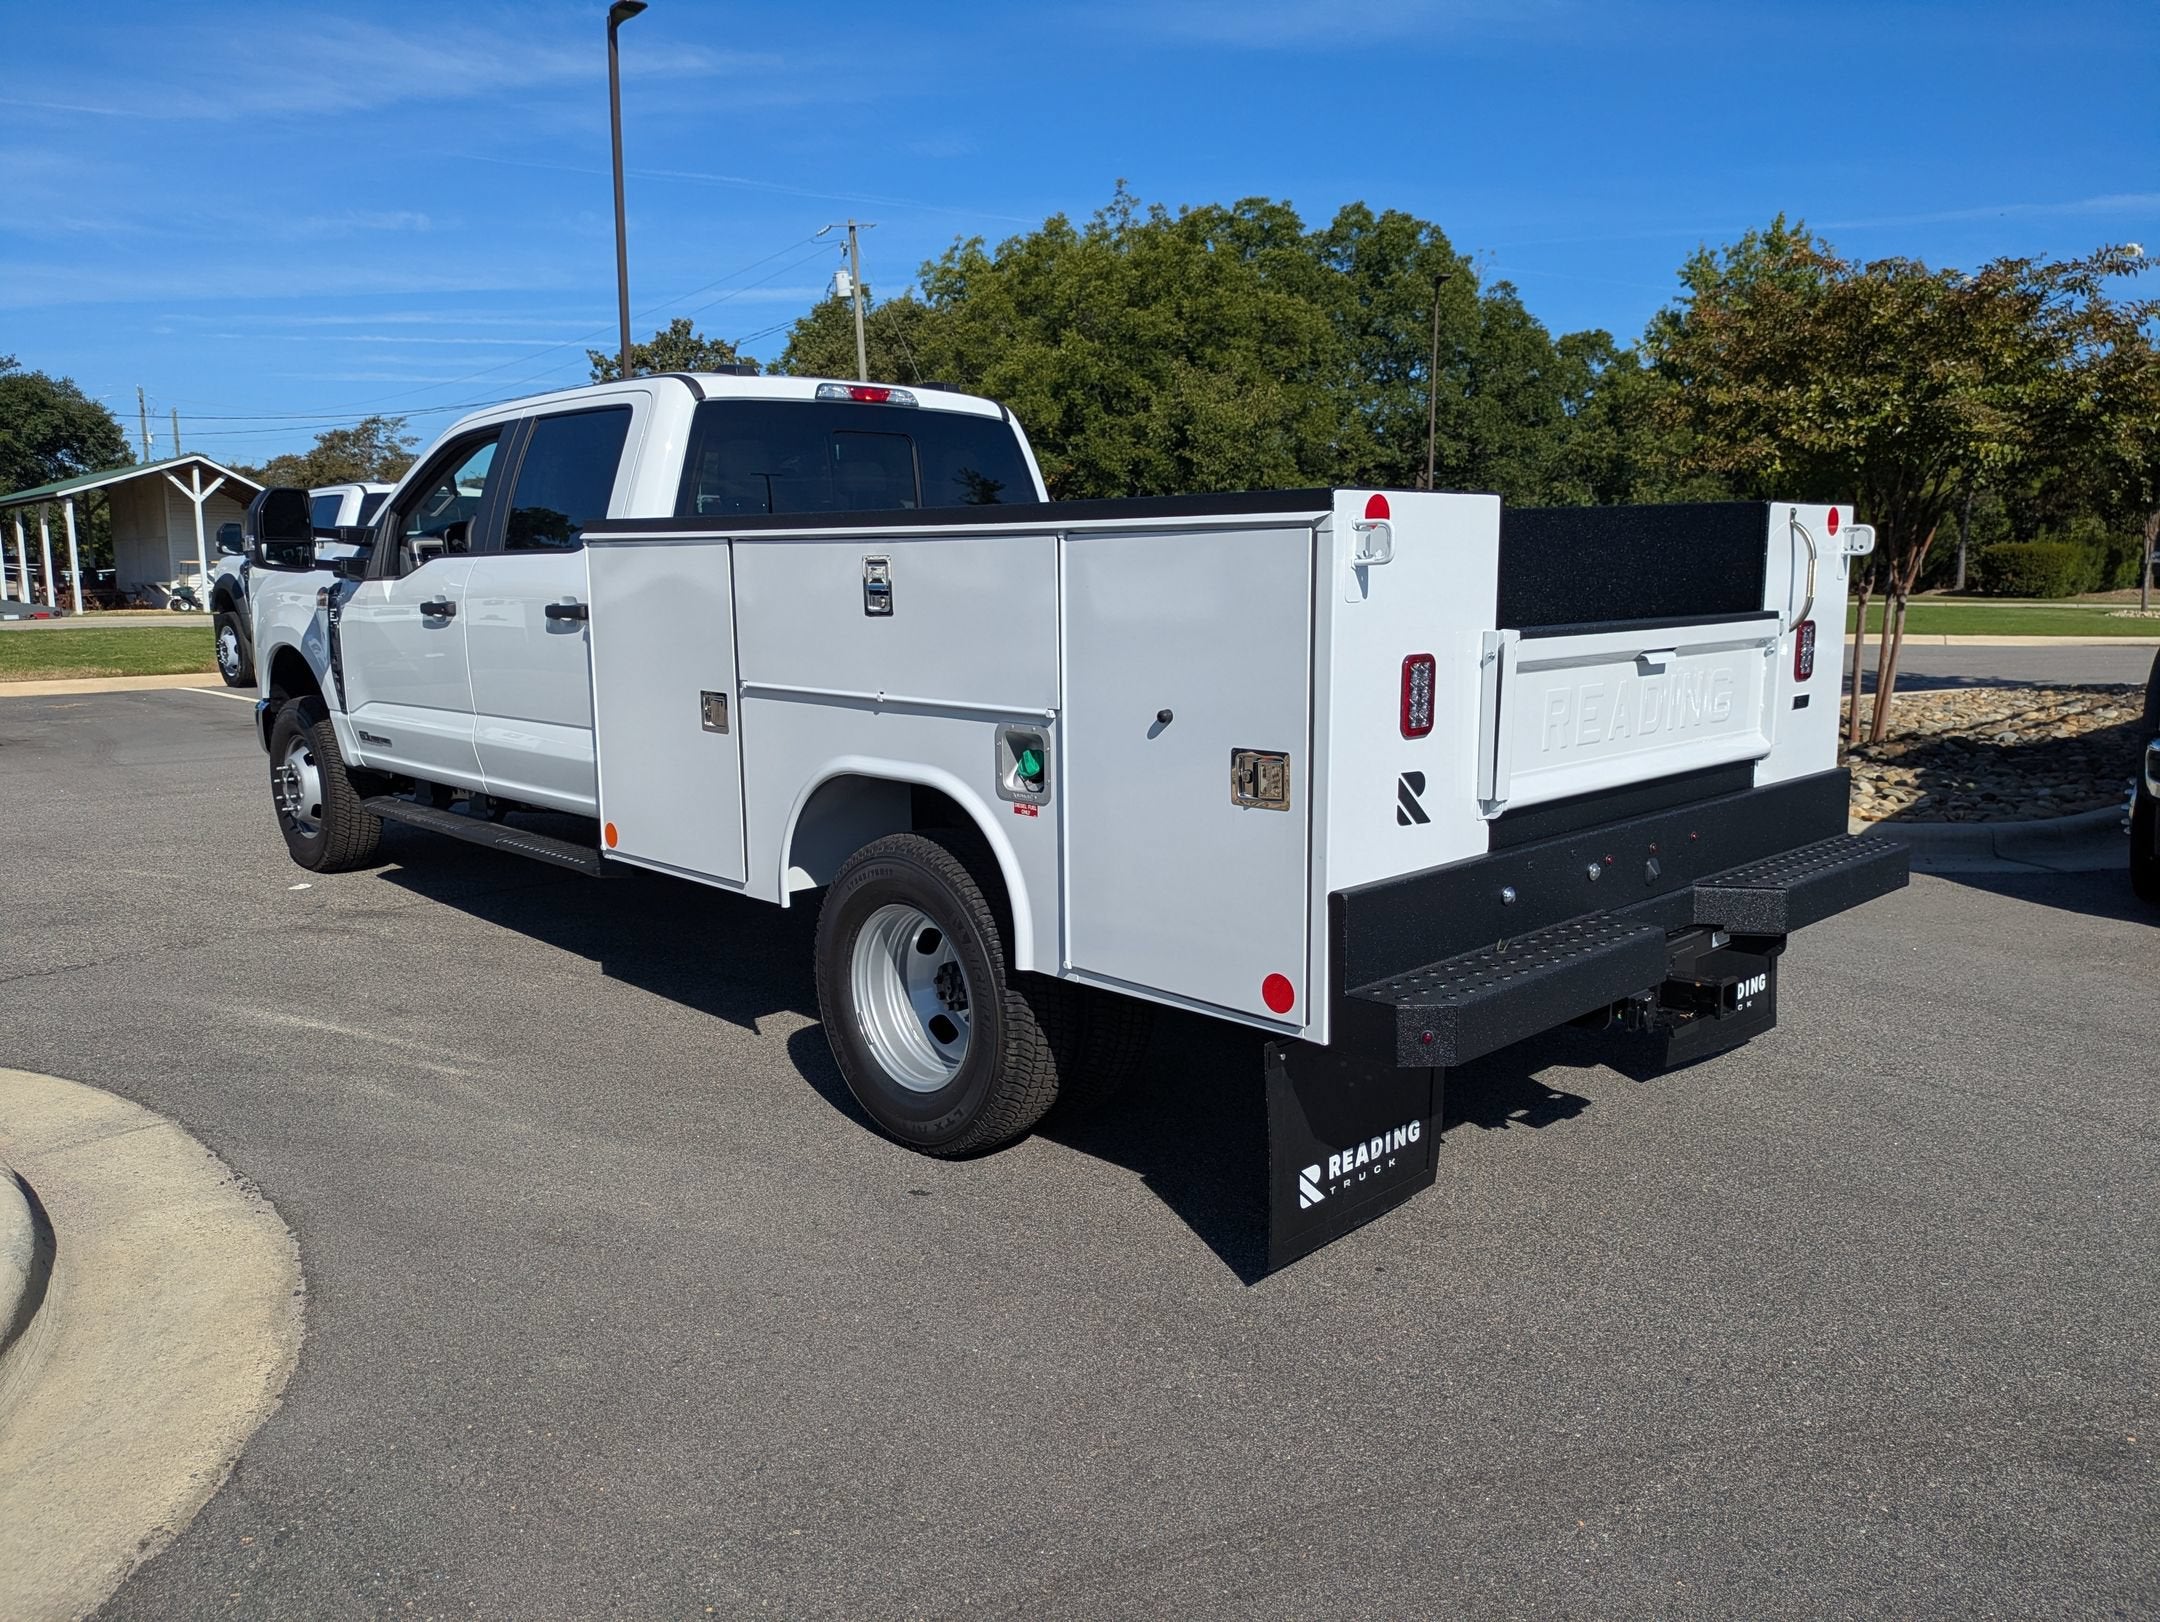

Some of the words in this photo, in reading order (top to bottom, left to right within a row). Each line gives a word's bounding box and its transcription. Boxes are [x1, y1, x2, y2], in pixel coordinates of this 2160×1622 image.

[1541, 666, 1736, 752] READING
[1736, 973, 1767, 1001] DING
[1328, 1119, 1421, 1180] READING
[1329, 1158, 1396, 1195] TRUCK
